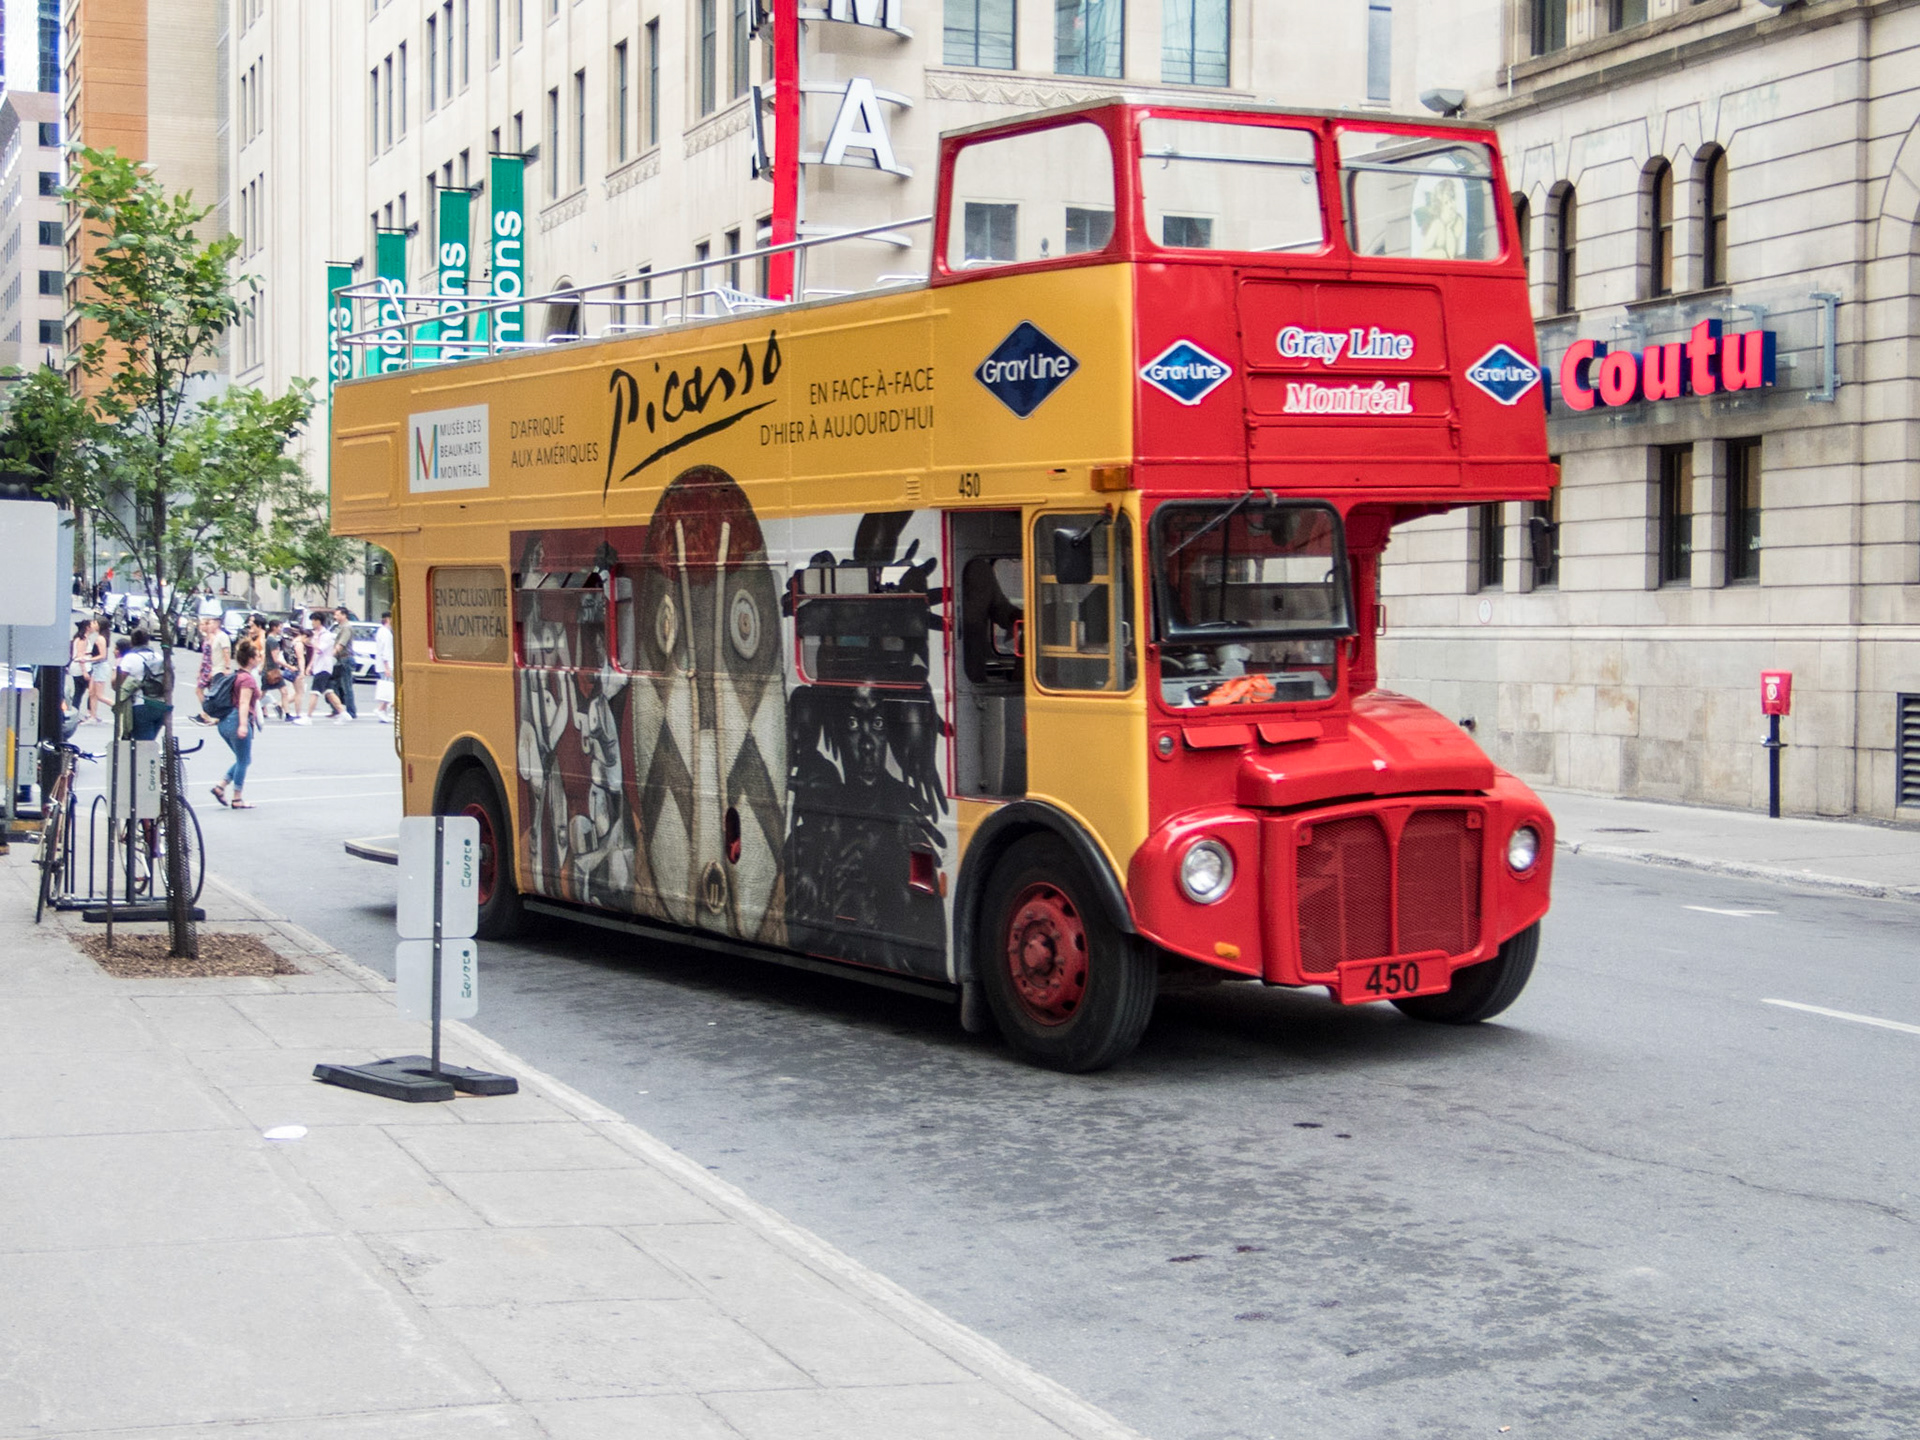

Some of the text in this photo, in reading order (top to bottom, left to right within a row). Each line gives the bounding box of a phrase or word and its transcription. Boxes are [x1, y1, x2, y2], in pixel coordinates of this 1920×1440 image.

[1278, 326, 1413, 365] Gray Line
[1560, 318, 1769, 411] Coutu
[810, 367, 935, 406] EN FACE-À-FACE
[1283, 380, 1413, 414] Montréal
[439, 419, 482, 437] MUSÉE DES
[511, 415, 565, 439] D'AFRIQUE
[603, 329, 782, 507] Picasso
[760, 405, 934, 446] D'HIER À AUJOURD'HUI
[440, 441, 482, 458] BEAUX-ARTS
[511, 442, 599, 468] AUX AMÉRIQUES
[440, 461, 482, 479] MONTRÉAL
[958, 472, 981, 499] 450
[435, 588, 447, 608] EN
[447, 610, 508, 639] MONTRÉAL
[1365, 962, 1419, 995] 450
